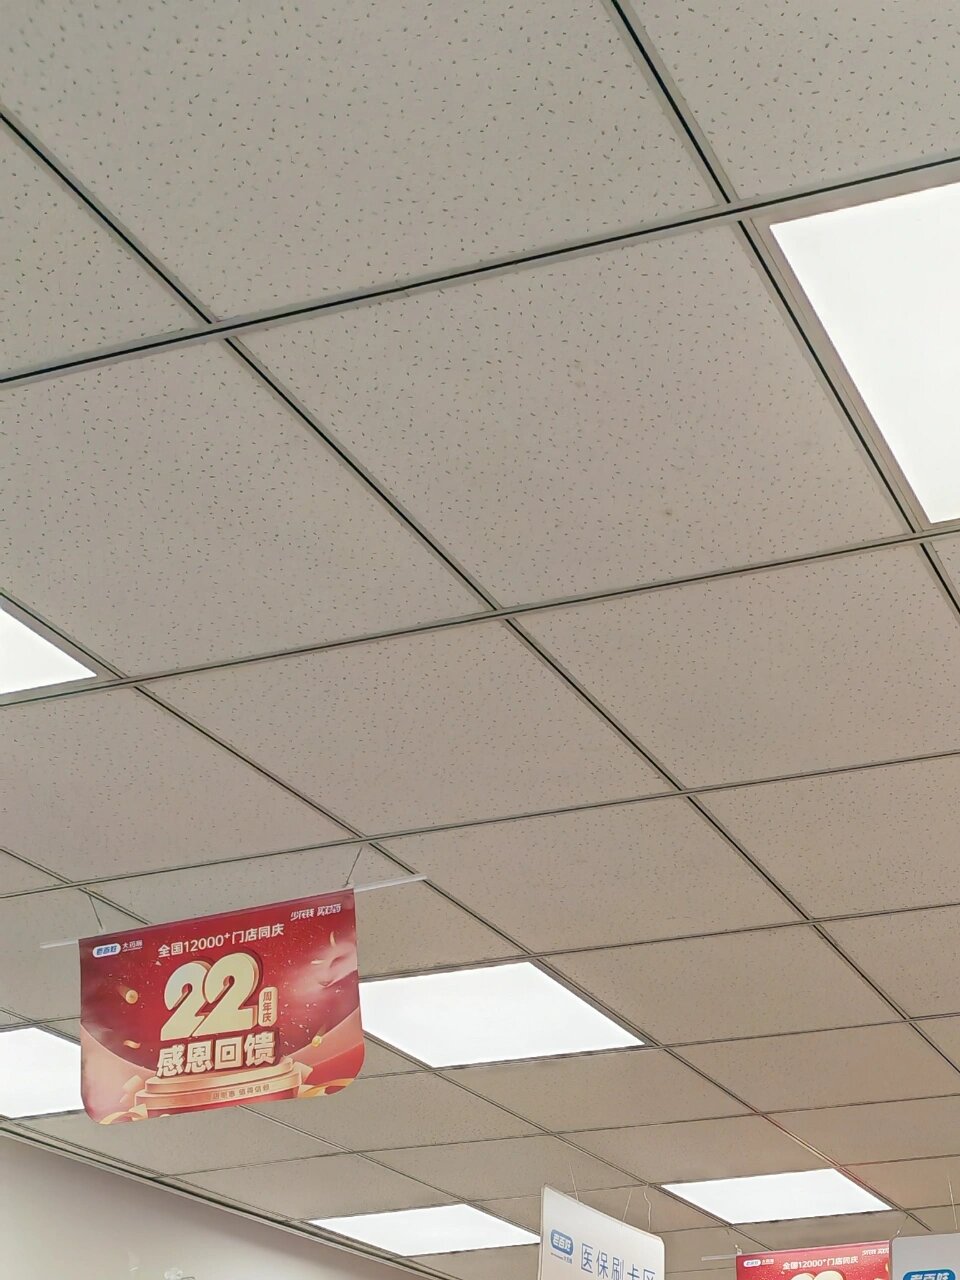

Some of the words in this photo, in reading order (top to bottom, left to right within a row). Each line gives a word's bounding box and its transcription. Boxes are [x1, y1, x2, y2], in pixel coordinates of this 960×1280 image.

[159, 951, 261, 1041] 22
[155, 1032, 277, 1078] 感恩回馈
